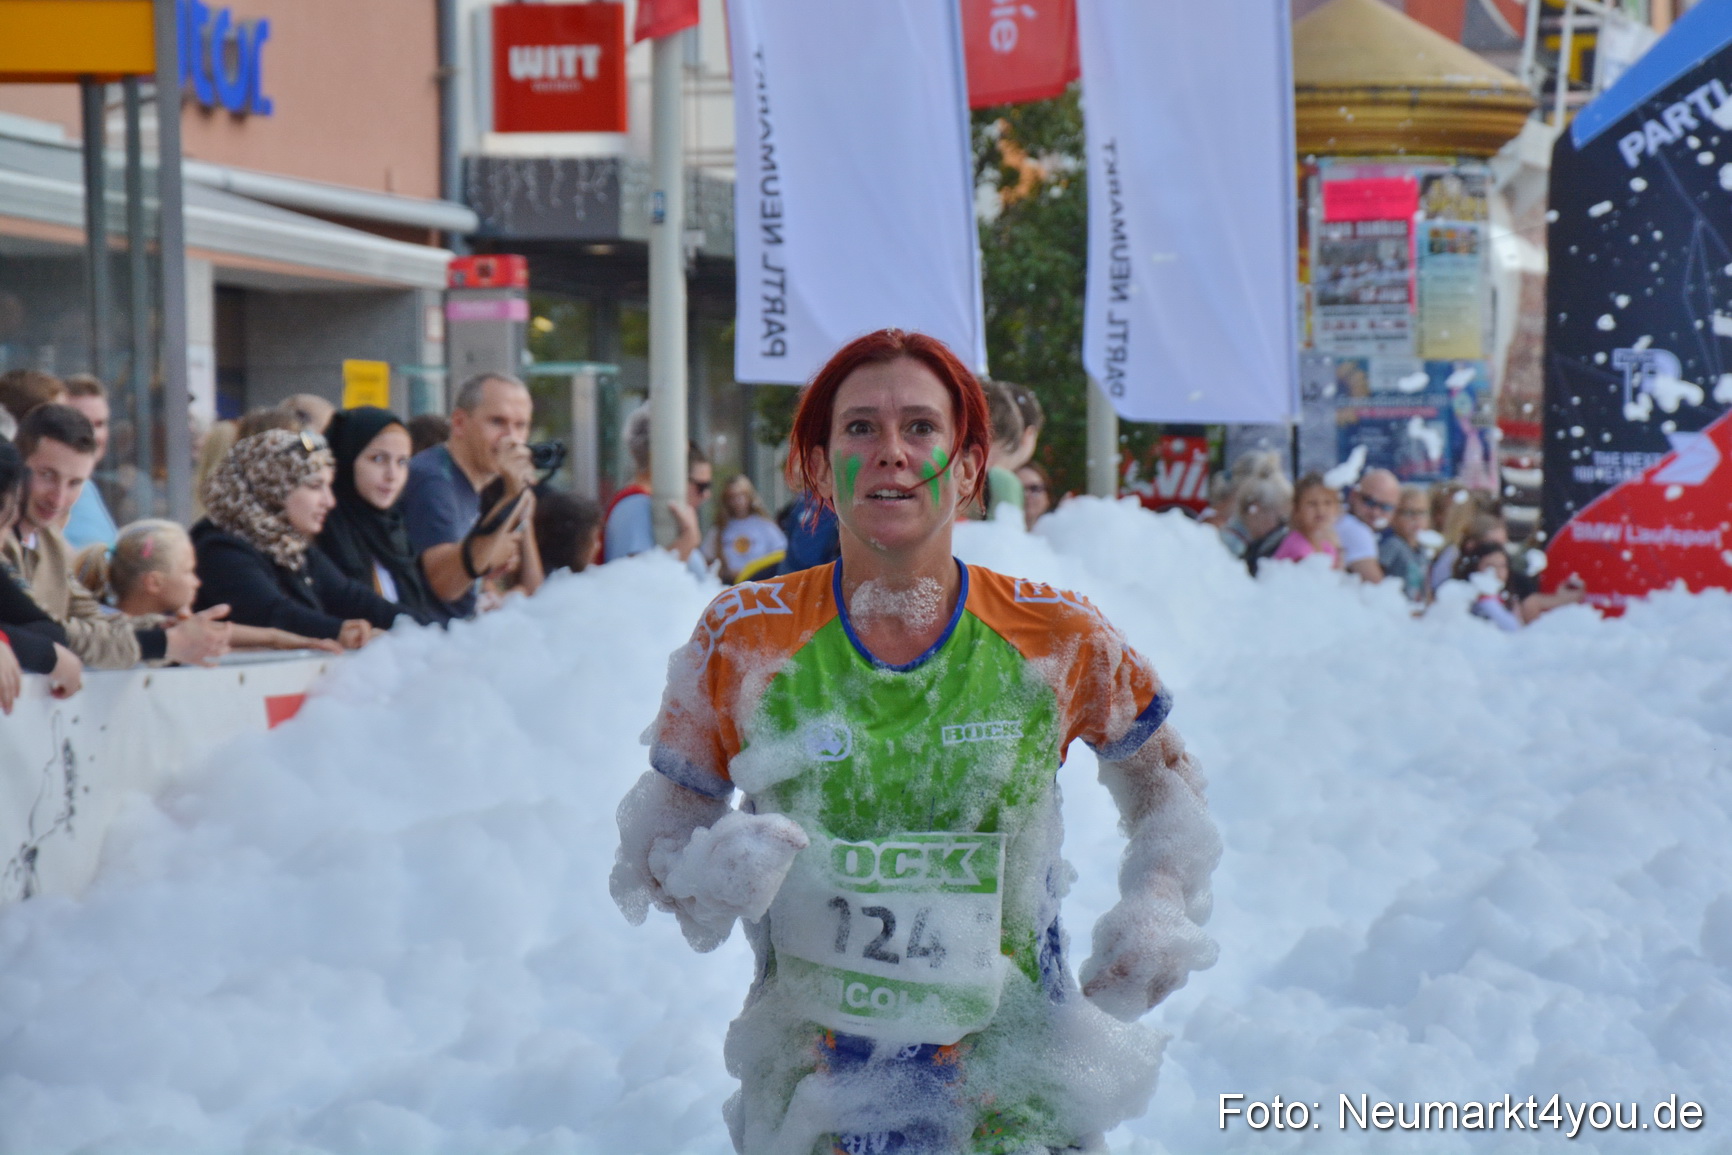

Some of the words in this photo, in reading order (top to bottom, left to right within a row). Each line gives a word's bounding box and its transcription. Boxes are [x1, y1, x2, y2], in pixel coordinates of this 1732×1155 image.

[507, 44, 601, 80] WITT
[942, 720, 1024, 746] BOCK
[828, 895, 948, 969] 124
